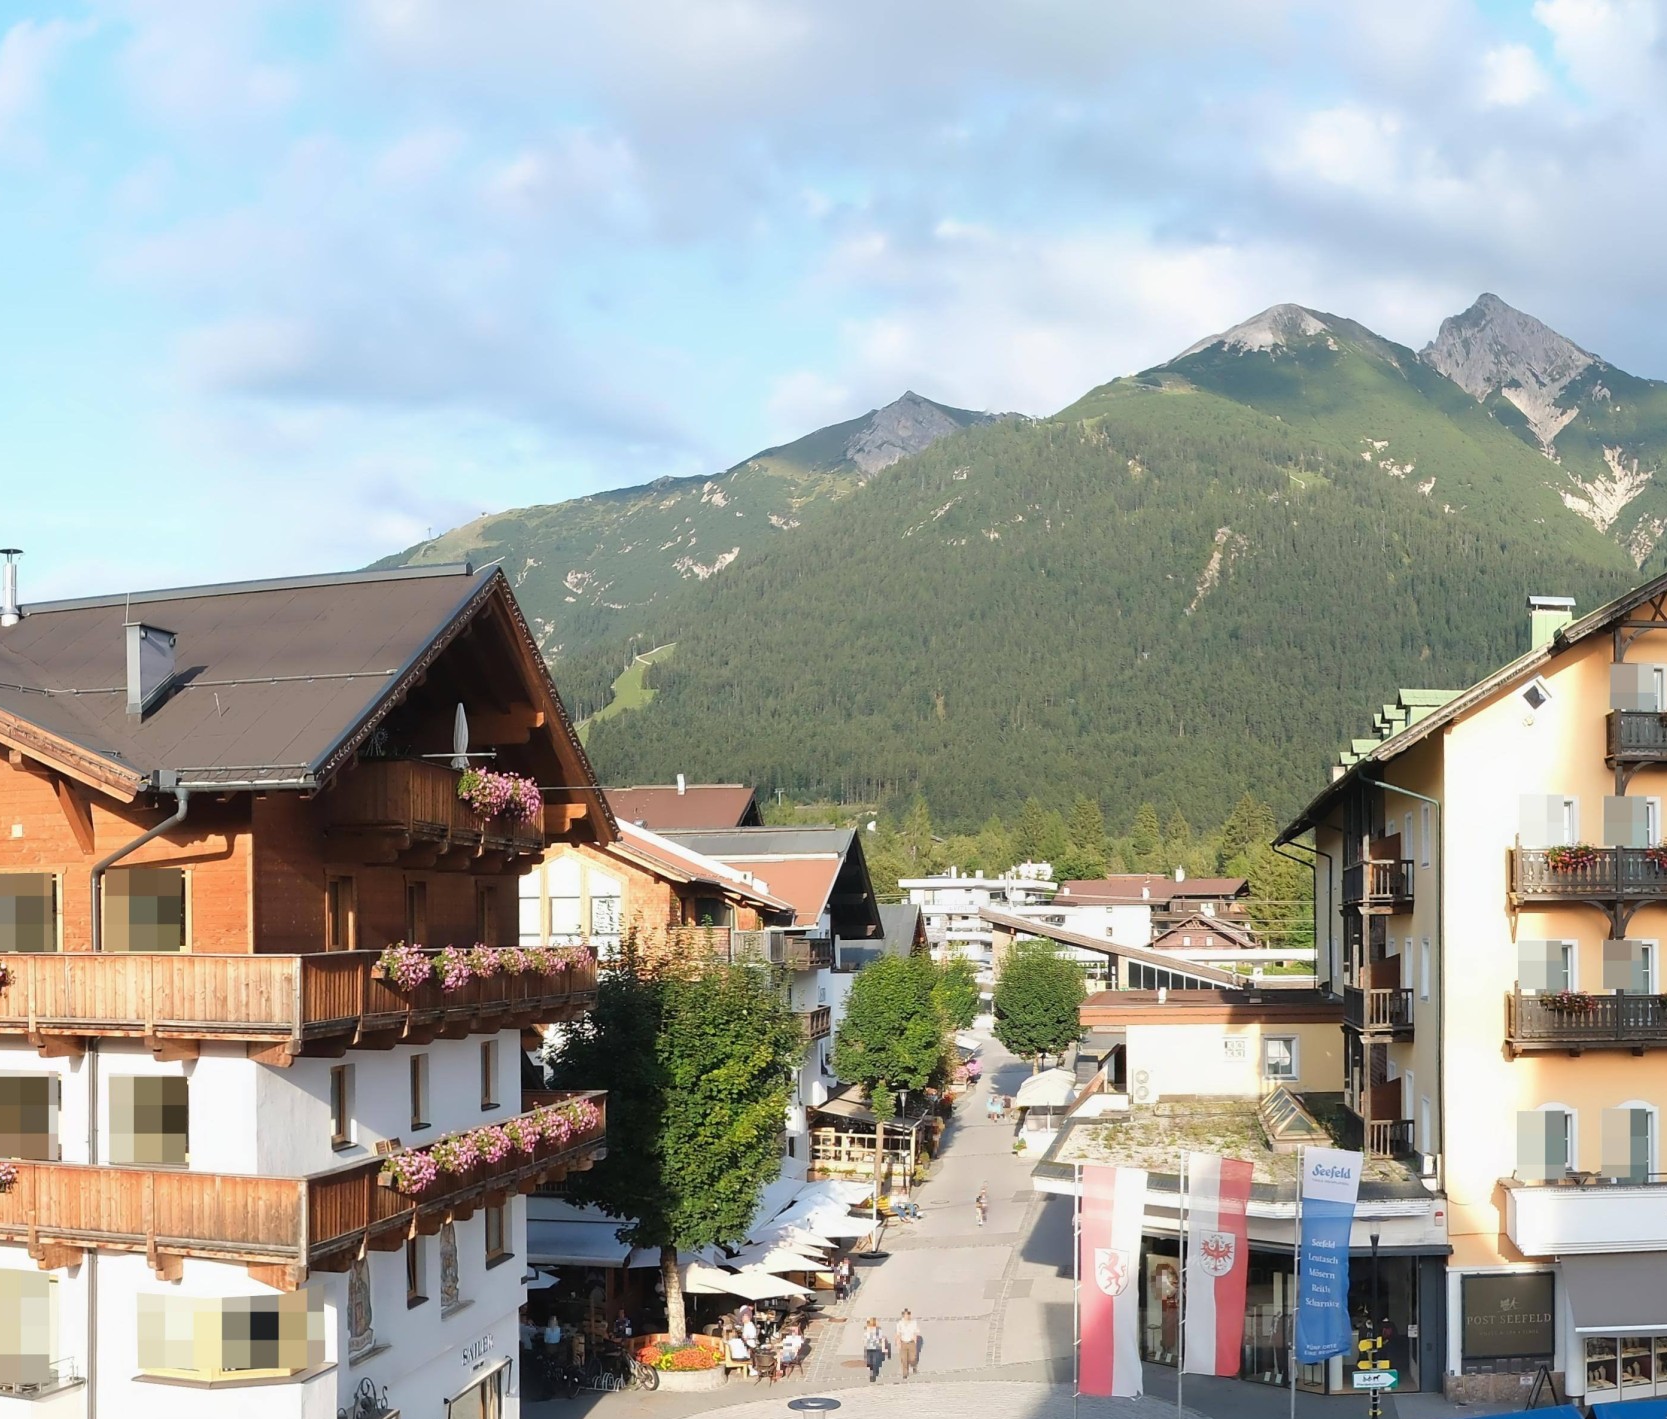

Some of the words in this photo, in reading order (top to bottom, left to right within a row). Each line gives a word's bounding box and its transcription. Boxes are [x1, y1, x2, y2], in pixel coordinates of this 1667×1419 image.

[1312, 1164, 1351, 1180] Seefeld
[1311, 1239, 1336, 1250] Seefeld
[1308, 1252, 1338, 1265] Leutasch
[1309, 1267, 1336, 1280] Mösern
[1311, 1284, 1331, 1294] Reith
[1467, 1315, 1494, 1325] POST
[1500, 1313, 1551, 1324] SEEFELD
